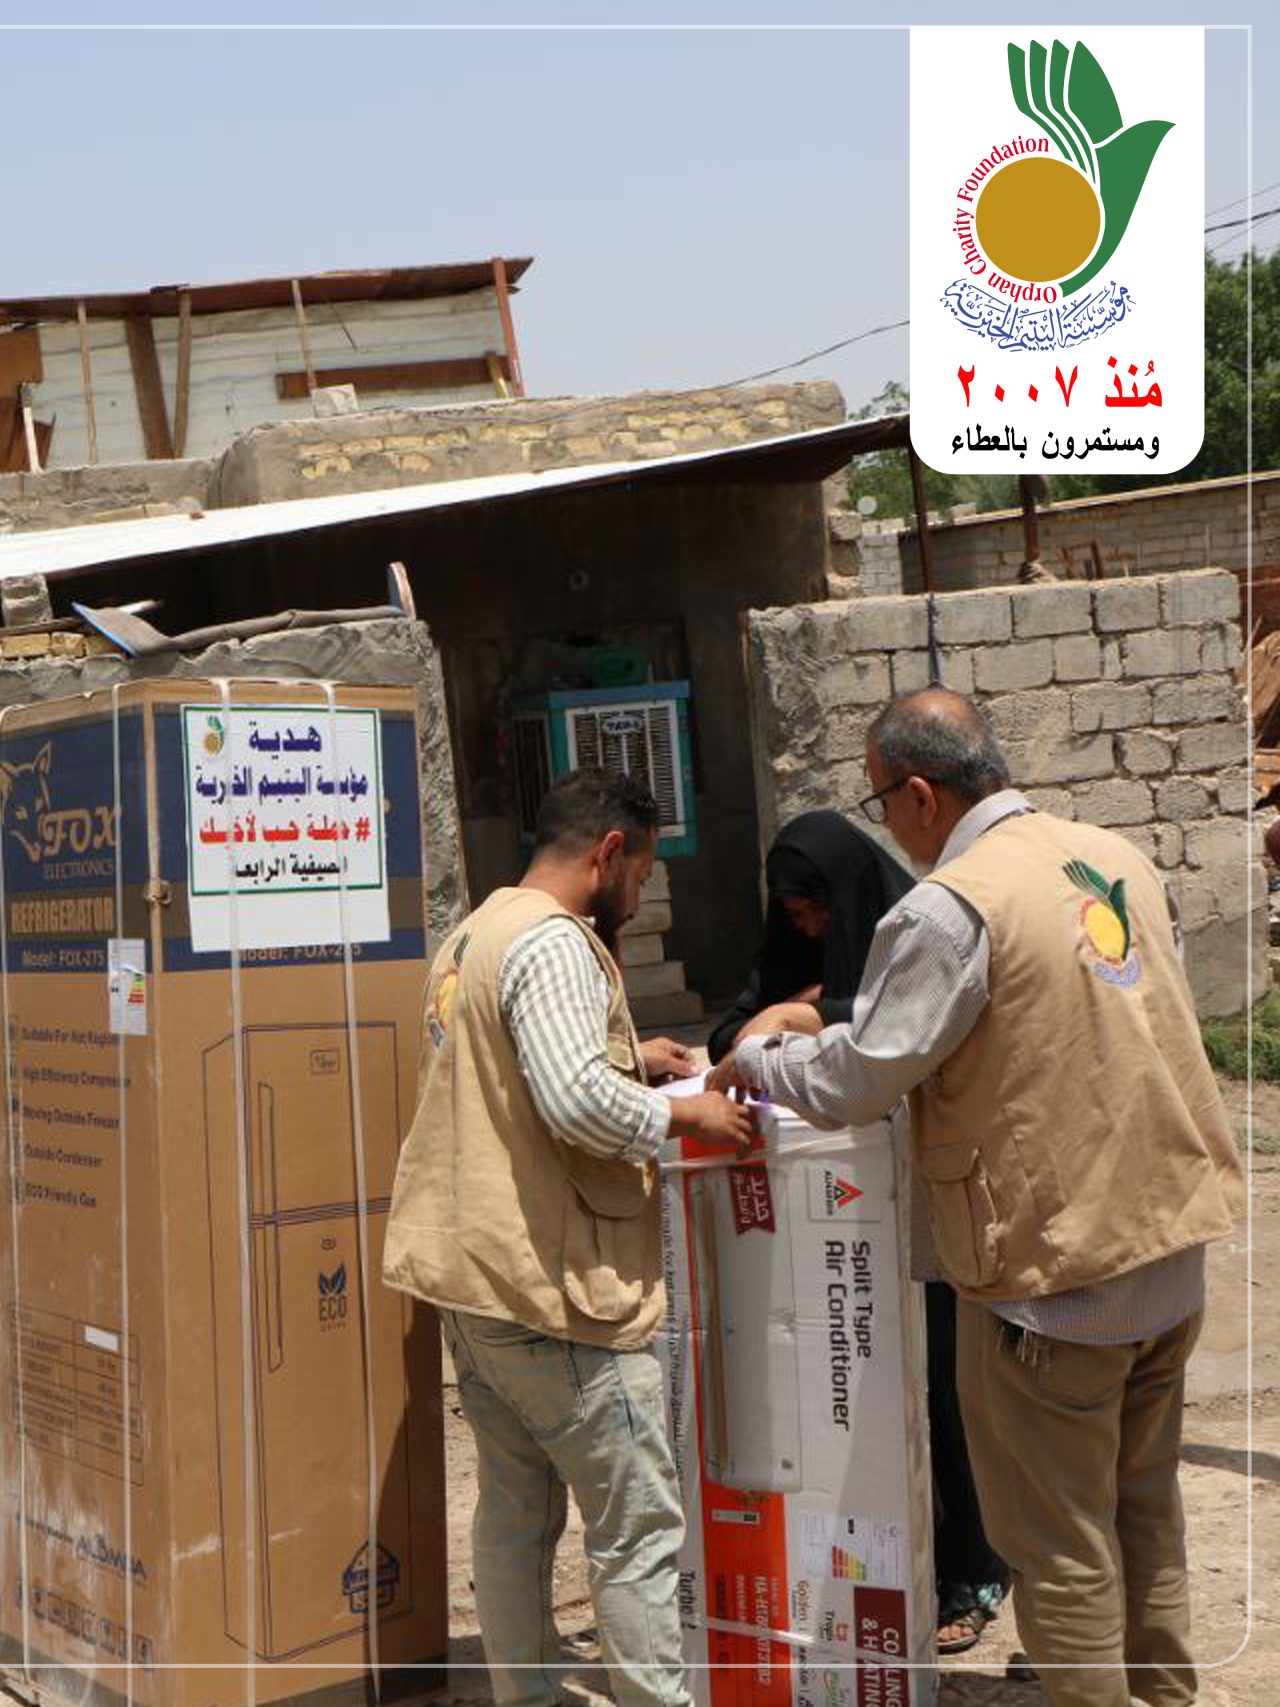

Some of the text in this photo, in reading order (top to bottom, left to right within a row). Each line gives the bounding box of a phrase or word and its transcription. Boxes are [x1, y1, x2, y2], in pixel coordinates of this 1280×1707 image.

[248, 721, 322, 760] هدية
[195, 764, 253, 805] الخرية
[37, 806, 122, 858] FOX
[11, 896, 115, 934] REFRIGERATOR
[292, 943, 362, 960] FOX-25
[852, 1240, 873, 1358] Split Type
[825, 1240, 849, 1432] Air Conditioner
[882, 1627, 902, 1707] COLING
